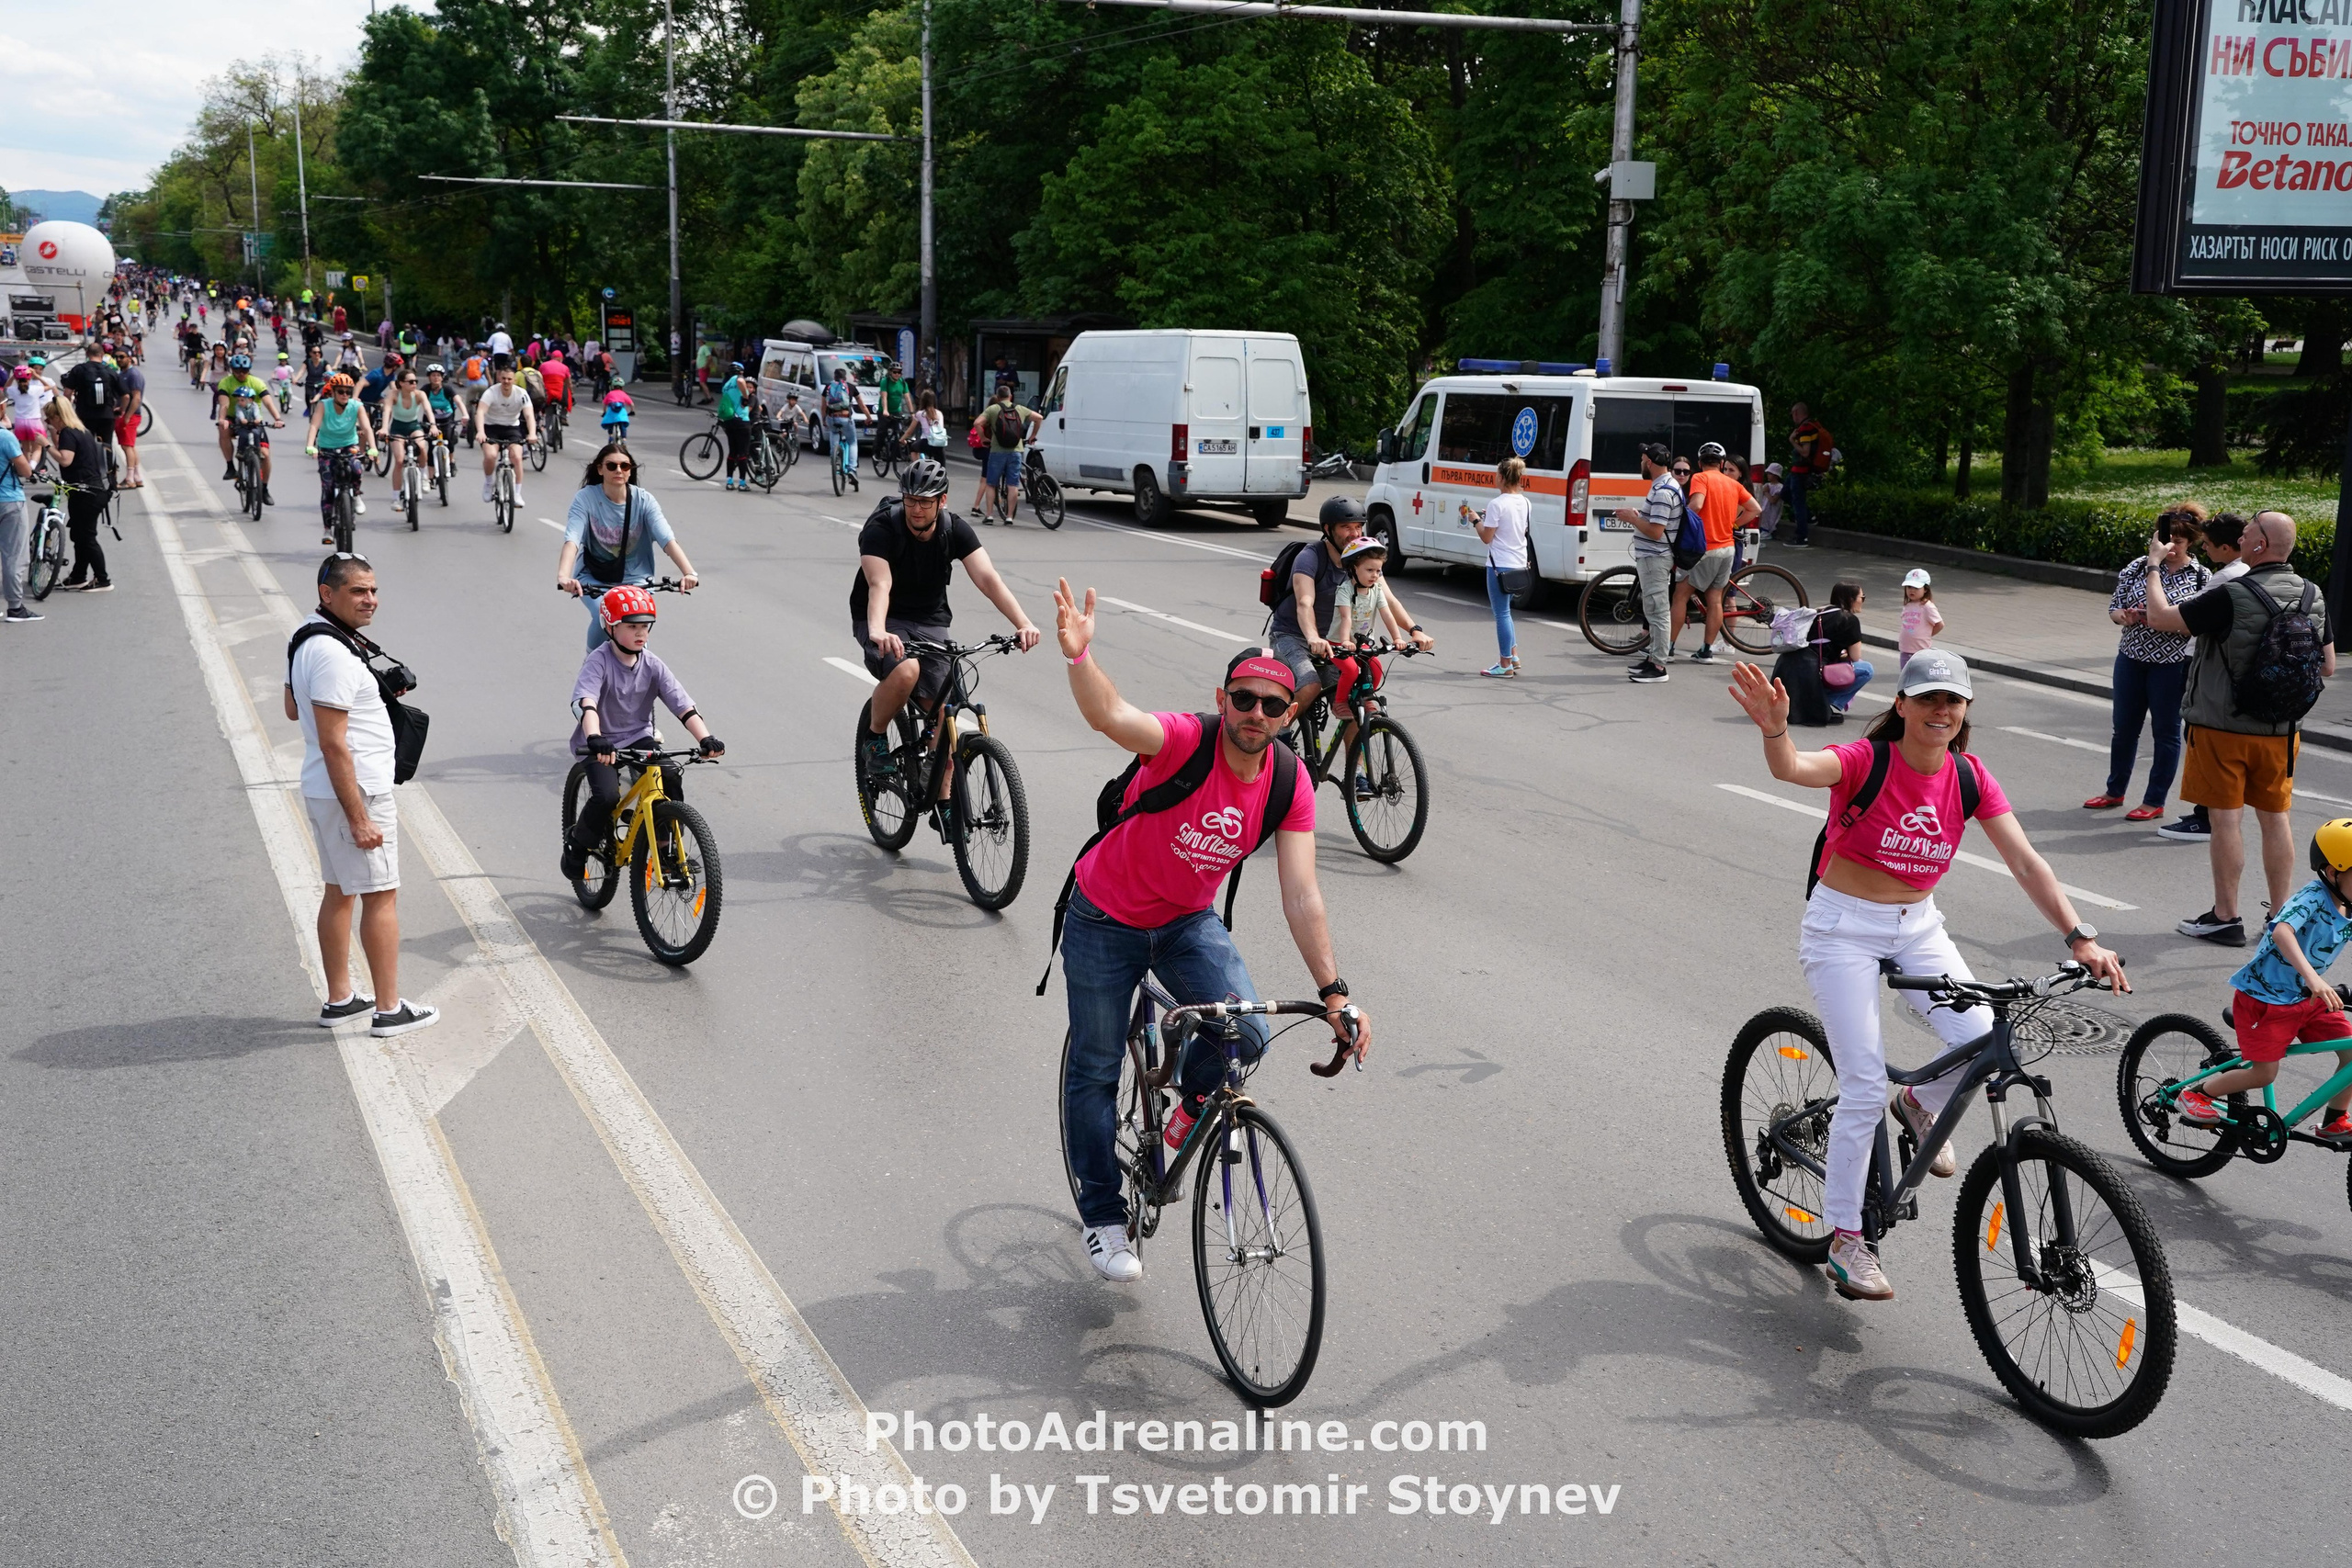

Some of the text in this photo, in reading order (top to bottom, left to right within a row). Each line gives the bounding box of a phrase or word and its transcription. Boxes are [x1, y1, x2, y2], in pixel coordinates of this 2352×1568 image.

[2211, 35, 2352, 79] НИ СЪБИ
[2231, 121, 2301, 146] ТОЧНО
[2216, 151, 2352, 192] Betano
[2189, 235, 2256, 260] ХАЗАРТЪТ
[2260, 236, 2299, 261] НОСИ
[2302, 237, 2339, 261] РИСК
[1212, 444, 1227, 452] 5165
[1442, 469, 1494, 486] ПЪРВА ГРАДСКА
[1605, 518, 1616, 528] CB
[1179, 822, 1204, 849] Giro
[1880, 827, 1912, 852] Giro
[1191, 852, 1216, 863] INFINITO
[1876, 849, 1901, 858] AMORE
[1912, 863, 1939, 874] SOFIA
